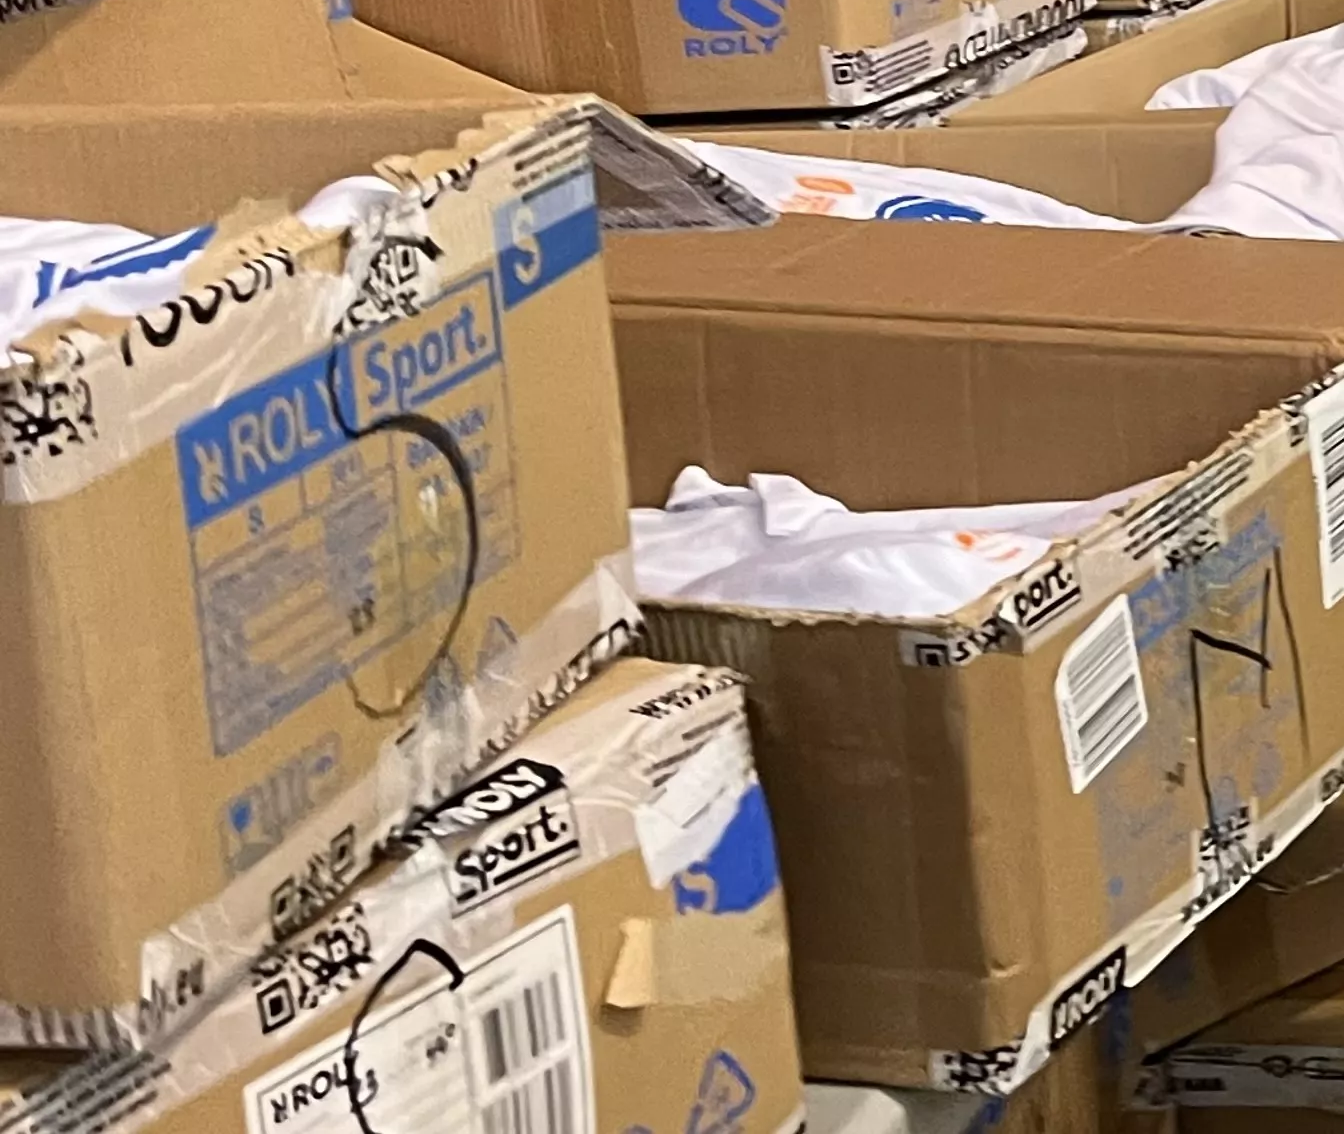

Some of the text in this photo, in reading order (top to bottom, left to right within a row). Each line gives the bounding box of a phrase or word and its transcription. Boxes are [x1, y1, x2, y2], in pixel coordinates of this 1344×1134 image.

[684, 32, 780, 59] ROLY
[229, 370, 342, 485] ROLY
[363, 306, 487, 412] Sport.
[455, 765, 549, 827] ROLY
[453, 805, 570, 903] Sport.
[1068, 958, 1122, 1029] ROLY
